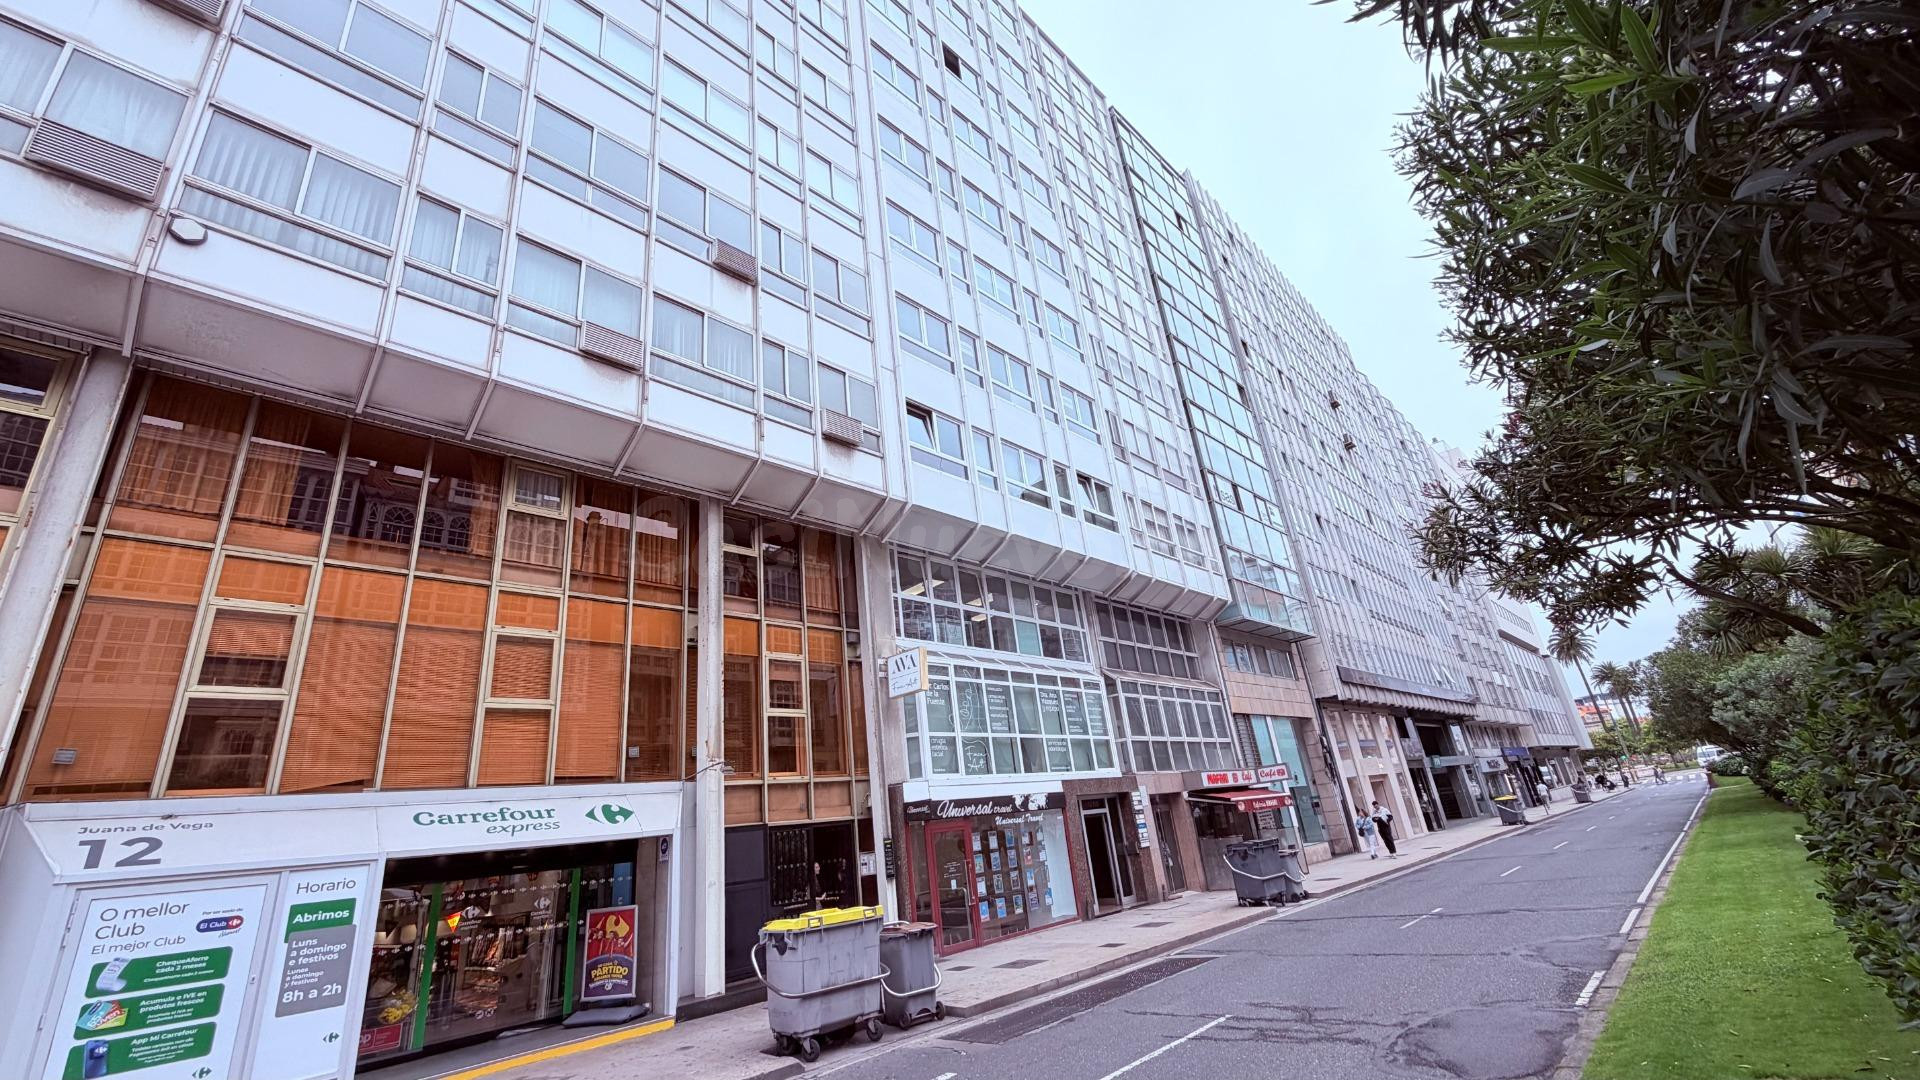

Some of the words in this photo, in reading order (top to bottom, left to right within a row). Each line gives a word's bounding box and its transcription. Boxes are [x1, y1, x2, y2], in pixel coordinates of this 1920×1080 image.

[936, 800, 993, 818] Universal
[413, 807, 556, 826] Carrefour
[995, 815, 1024, 825] Universal
[1025, 813, 1044, 822] Travel
[78, 826, 136, 834] Juana
[169, 822, 214, 830] Vega
[486, 820, 560, 836] express
[78, 836, 163, 869] 12
[296, 878, 357, 894] Horario
[101, 908, 118, 921] O
[123, 903, 190, 920] mellor
[292, 909, 350, 924] Abrimos
[95, 922, 145, 939] Club
[209, 920, 227, 928] Club
[92, 945, 106, 955] El
[108, 939, 151, 953] mejor
[154, 935, 186, 947] Club
[292, 937, 318, 948] Luns
[300, 942, 347, 955] domingo
[298, 952, 339, 965] festivos
[287, 967, 308, 975] Lunes
[292, 970, 324, 980] domingo
[591, 965, 628, 979] PARTIDO
[291, 977, 318, 986] festivos
[282, 989, 304, 1003] 8h
[308, 989, 318, 998] a
[322, 982, 342, 996] 2h
[140, 996, 175, 1006] Acumula
[130, 1037, 149, 1046] App
[161, 1029, 199, 1039] Carrefour
